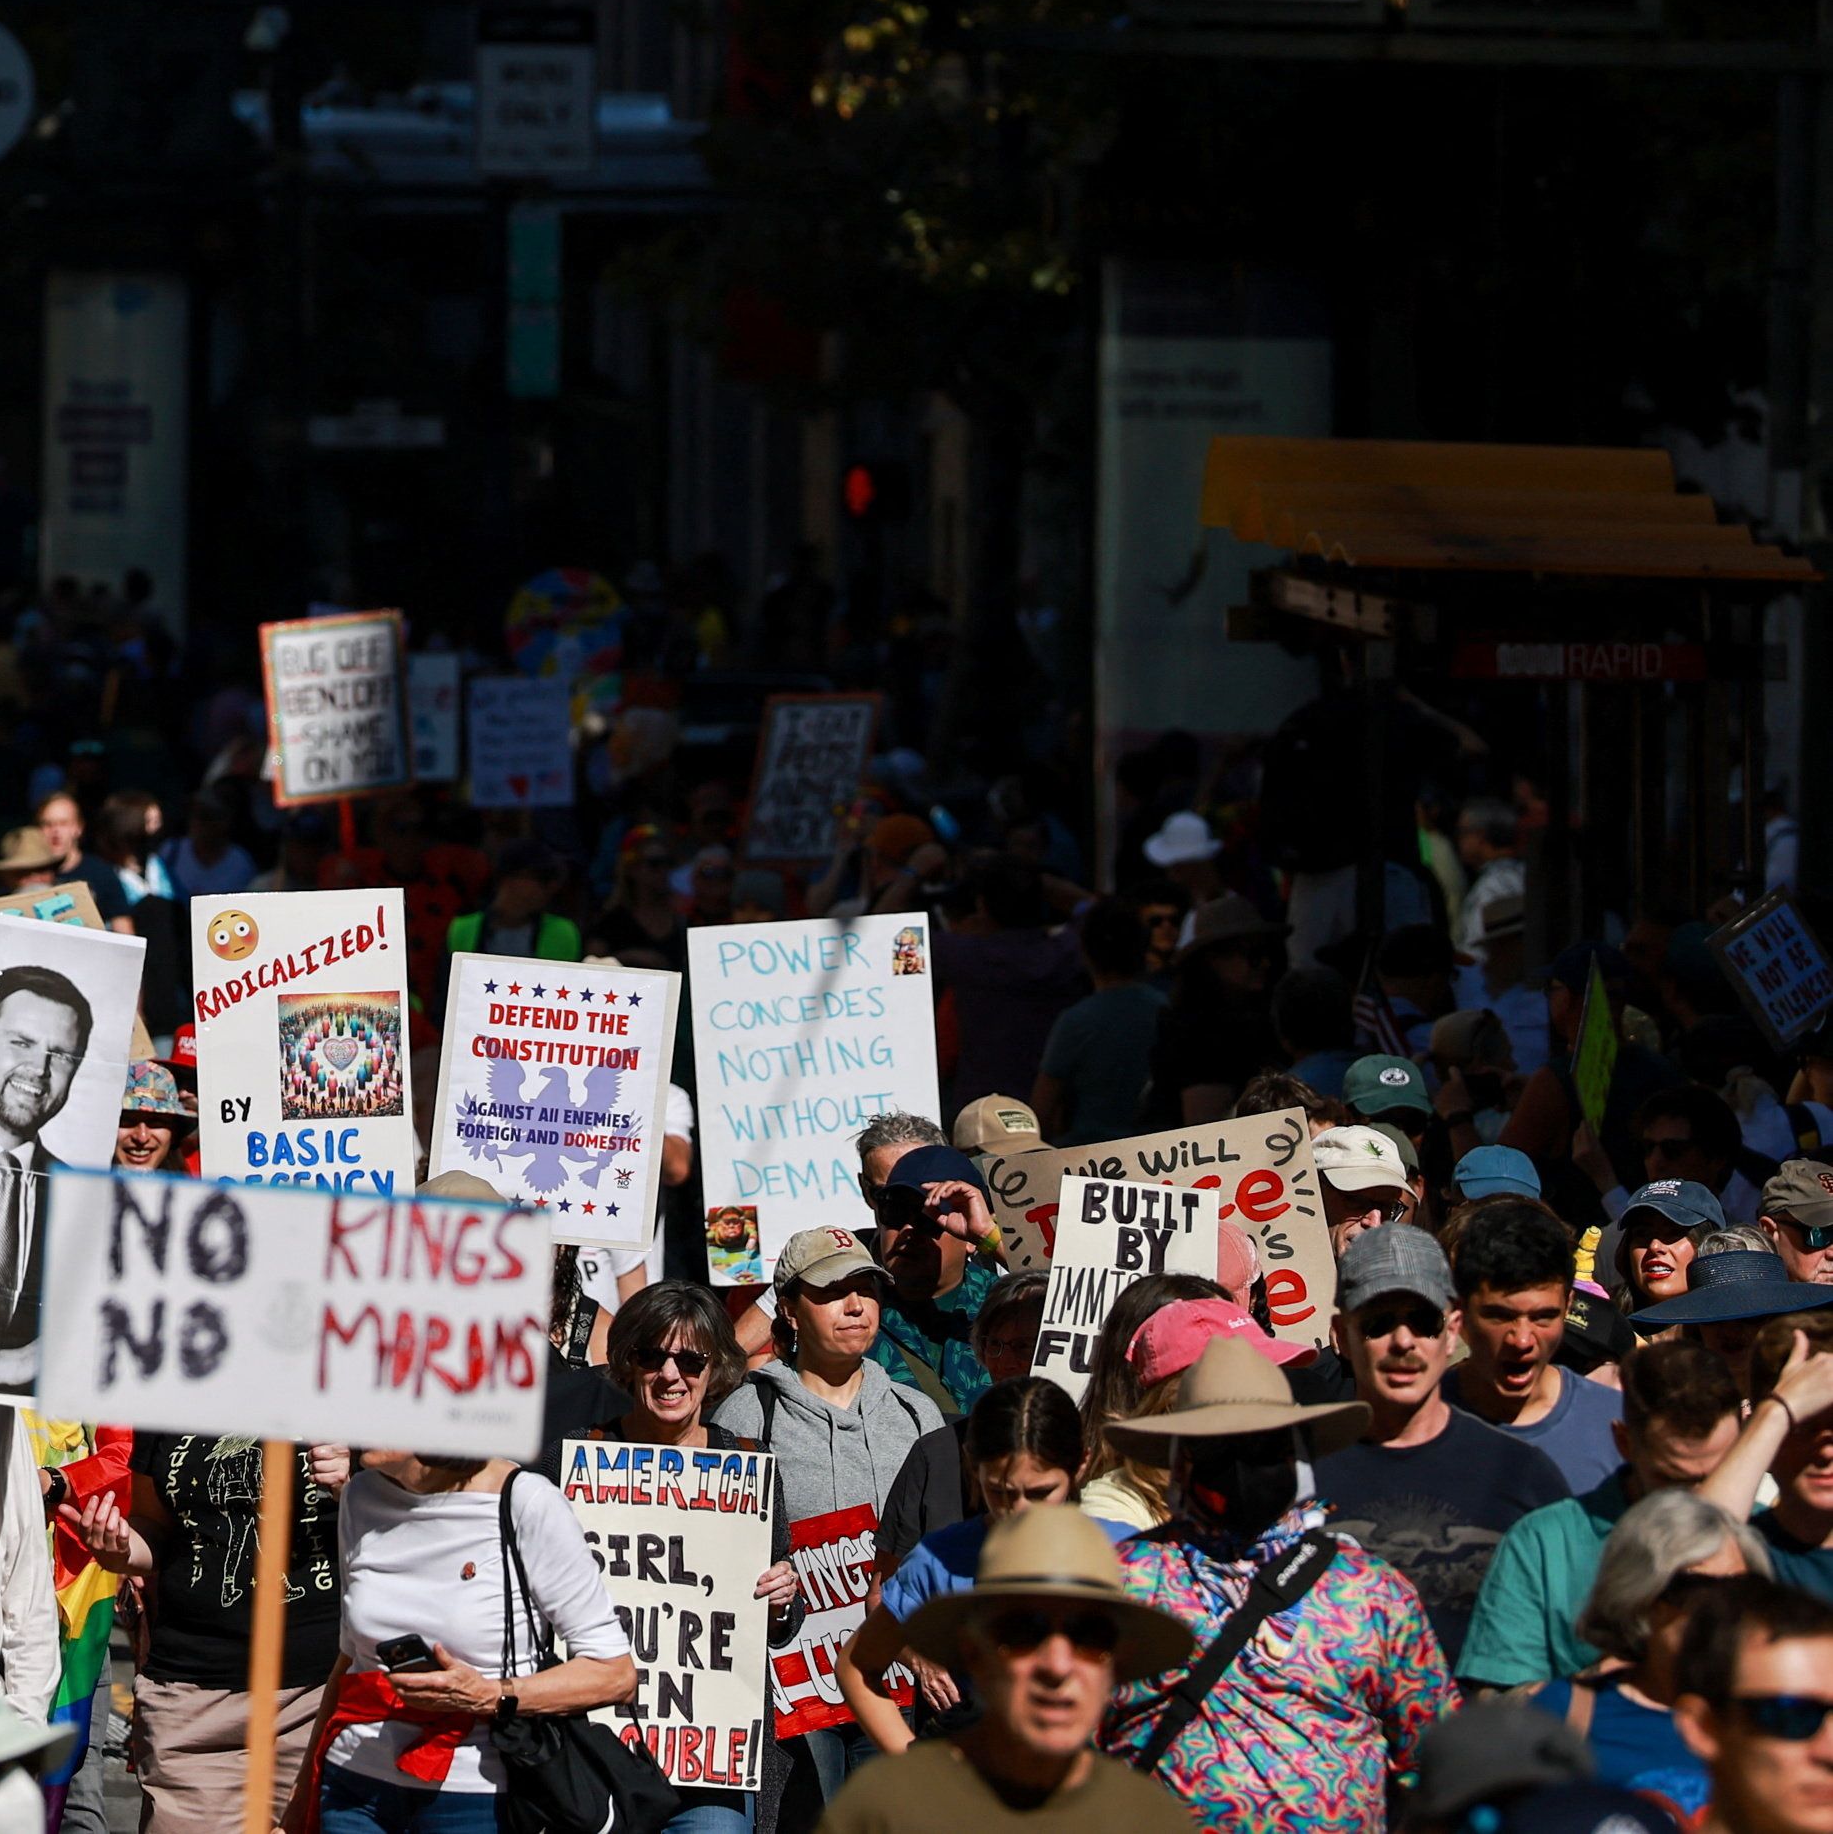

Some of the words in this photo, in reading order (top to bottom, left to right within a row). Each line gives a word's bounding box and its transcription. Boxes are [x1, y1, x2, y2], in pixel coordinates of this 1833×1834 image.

[1569, 643, 1663, 679] RAPID
[195, 905, 389, 1022] RADICALIZED!
[717, 932, 871, 978] POWER
[489, 1003, 580, 1033] DEFEND
[586, 1011, 629, 1036] THE
[709, 986, 886, 1031] CONCEDES
[471, 1034, 639, 1071] CONSTITUTION
[717, 1035, 895, 1087] NOTHING
[221, 1096, 251, 1123] BY
[466, 1100, 535, 1123] AGAINST
[563, 1107, 631, 1130] ENEMIES
[247, 1128, 361, 1167] BASIC
[456, 1122, 522, 1144] FOREIGN
[526, 1128, 559, 1146] AND
[563, 1131, 641, 1154] DOMESTIC
[616, 1177, 630, 1186] NO
[732, 1158, 863, 1200] DEMA
[1081, 1182, 1199, 1233] BUILT
[108, 1182, 252, 1285] NO
[322, 1197, 526, 1286] KINGS
[825, 1228, 853, 1250] B
[1115, 1227, 1173, 1273] BY
[97, 1298, 230, 1393] NO
[564, 1445, 775, 1523] AMERICA!
[614, 1668, 694, 1723] IN
